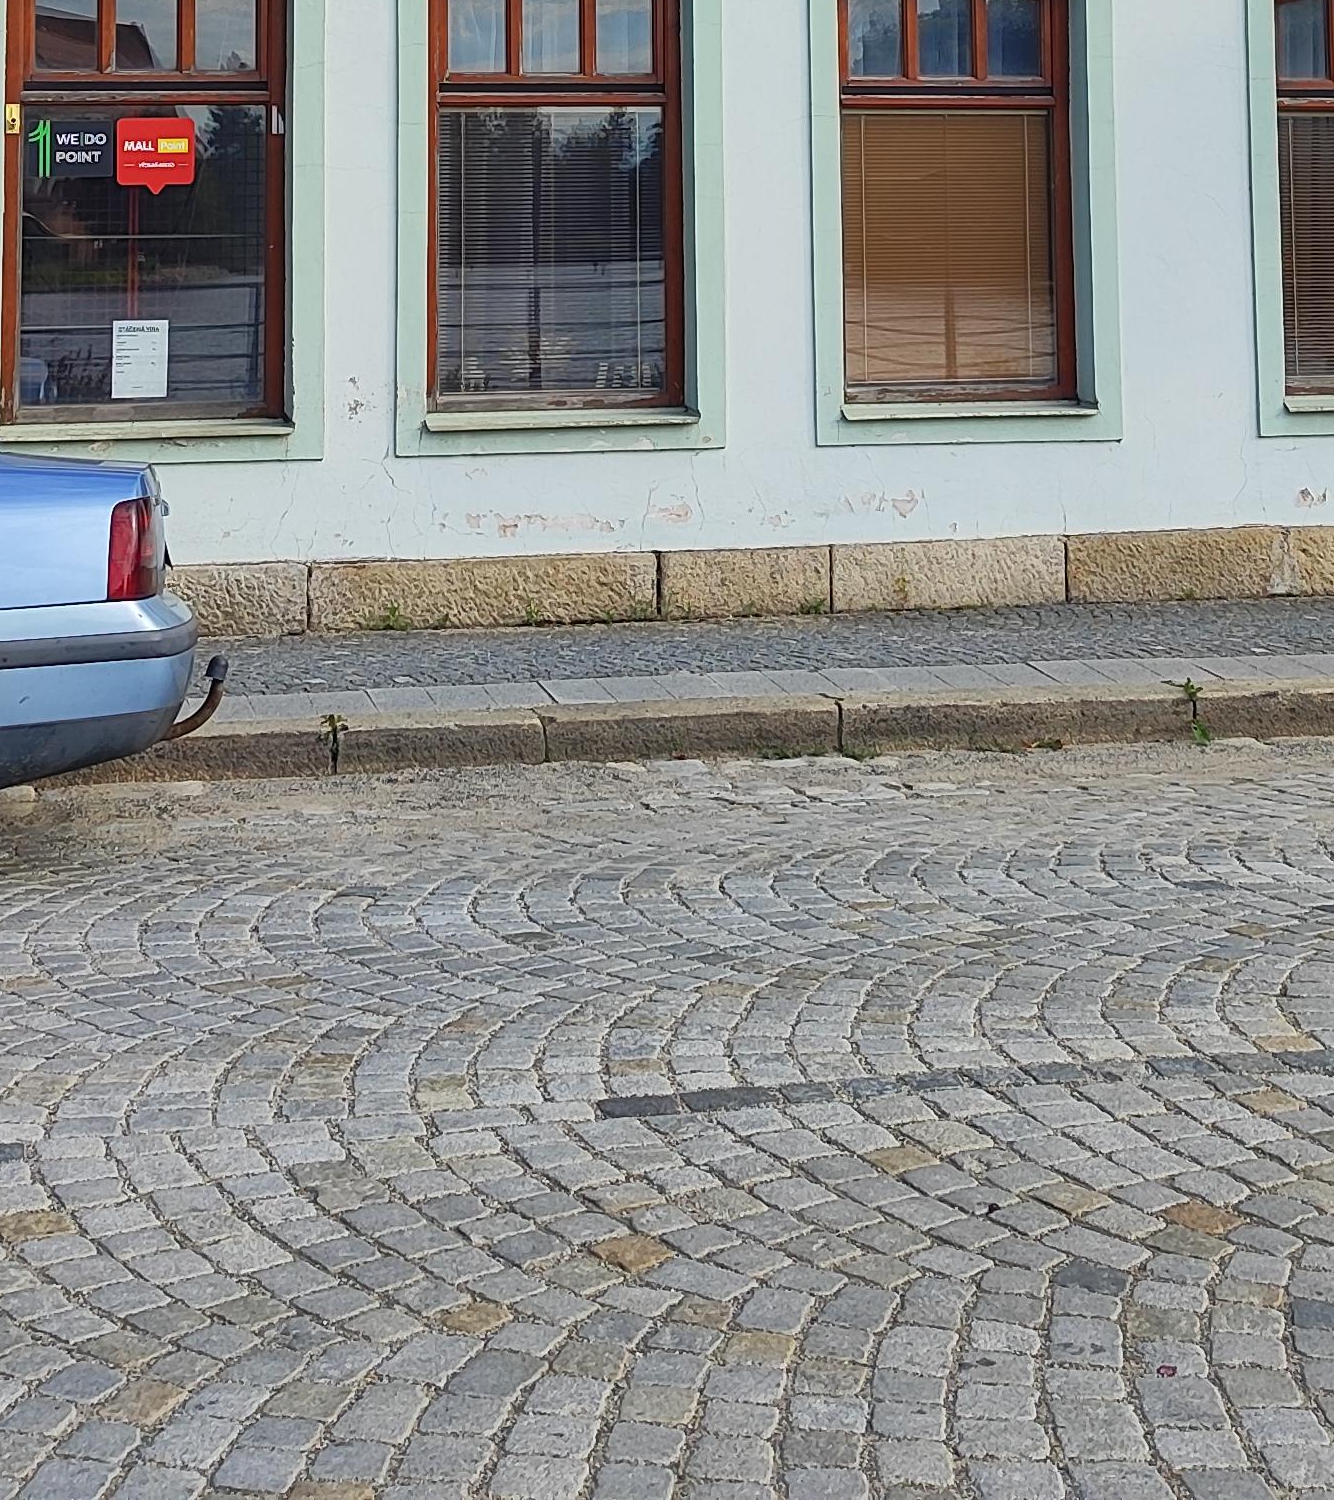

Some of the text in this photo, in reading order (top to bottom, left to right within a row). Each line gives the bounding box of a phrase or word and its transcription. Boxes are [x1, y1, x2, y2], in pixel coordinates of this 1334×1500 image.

[123, 140, 186, 152] MALL Point
[55, 151, 102, 164] POINT
